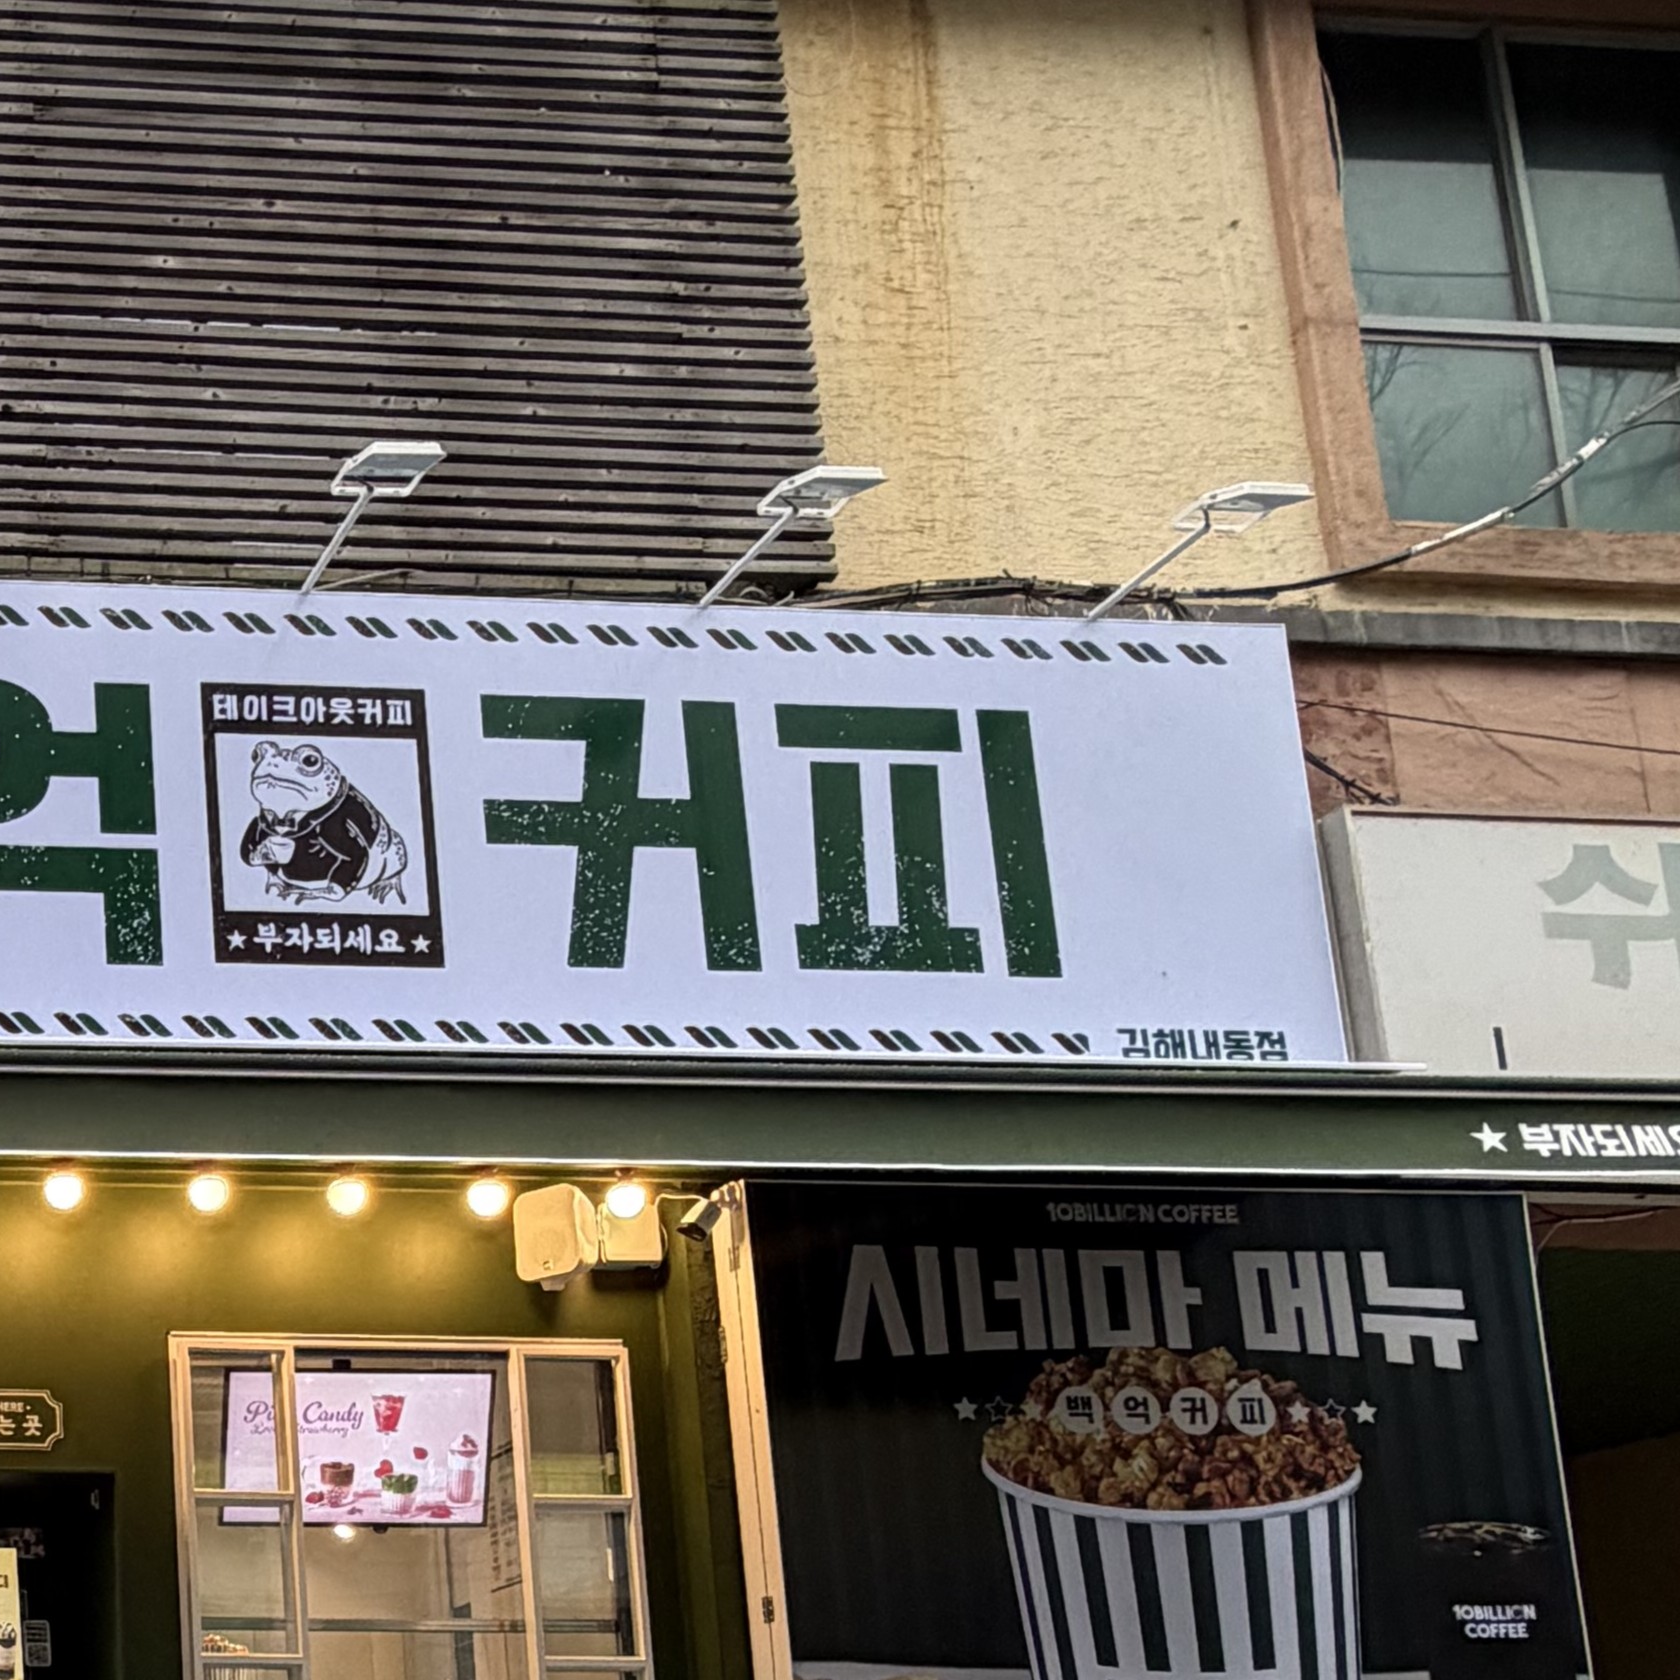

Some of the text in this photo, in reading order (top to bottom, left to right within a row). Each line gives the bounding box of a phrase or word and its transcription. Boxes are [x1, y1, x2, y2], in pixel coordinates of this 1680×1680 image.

[212, 694, 413, 726] 테이크아웃커피
[479, 693, 1063, 979] 커피
[253, 922, 405, 955] 부자되세요
[1116, 1028, 1289, 1061] 김해내동점
[1046, 1202, 1239, 1224] 10BILLION COFFEE
[834, 1244, 1478, 1371] 시네마 메뉴
[22, 1415, 43, 1436] 곳
[303, 1401, 363, 1430] Candy
[1452, 1604, 1537, 1621] 10BILLION
[1464, 1622, 1529, 1638] COFFEE
